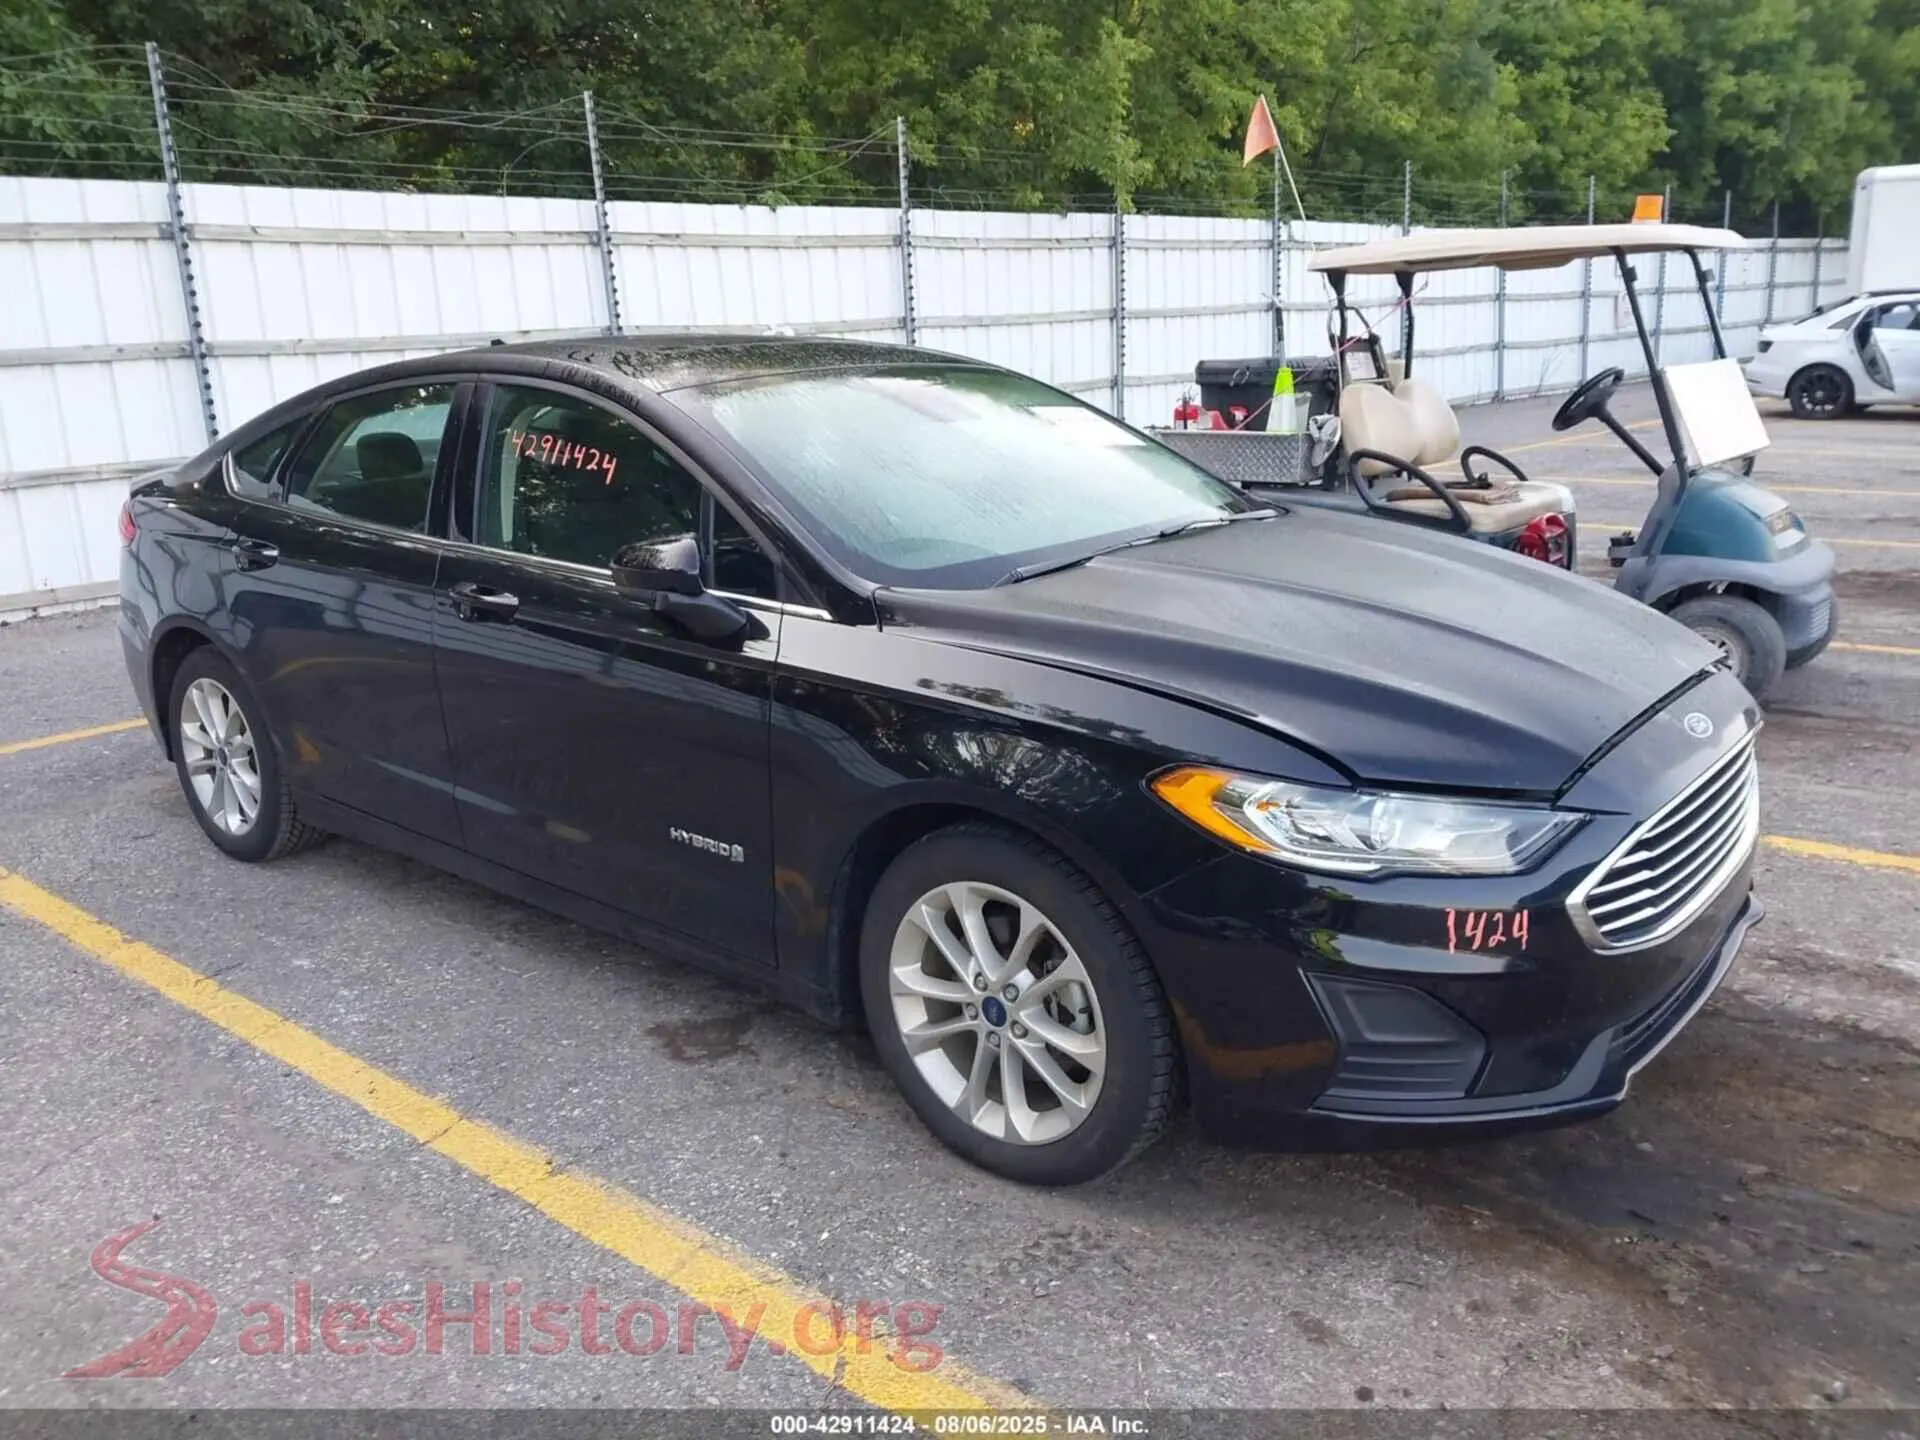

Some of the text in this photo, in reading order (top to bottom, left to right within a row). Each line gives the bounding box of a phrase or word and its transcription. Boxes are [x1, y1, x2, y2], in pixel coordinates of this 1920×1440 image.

[511, 429, 617, 485] 42911424
[669, 826, 730, 856] HYBRID
[1444, 907, 1529, 955] 1424
